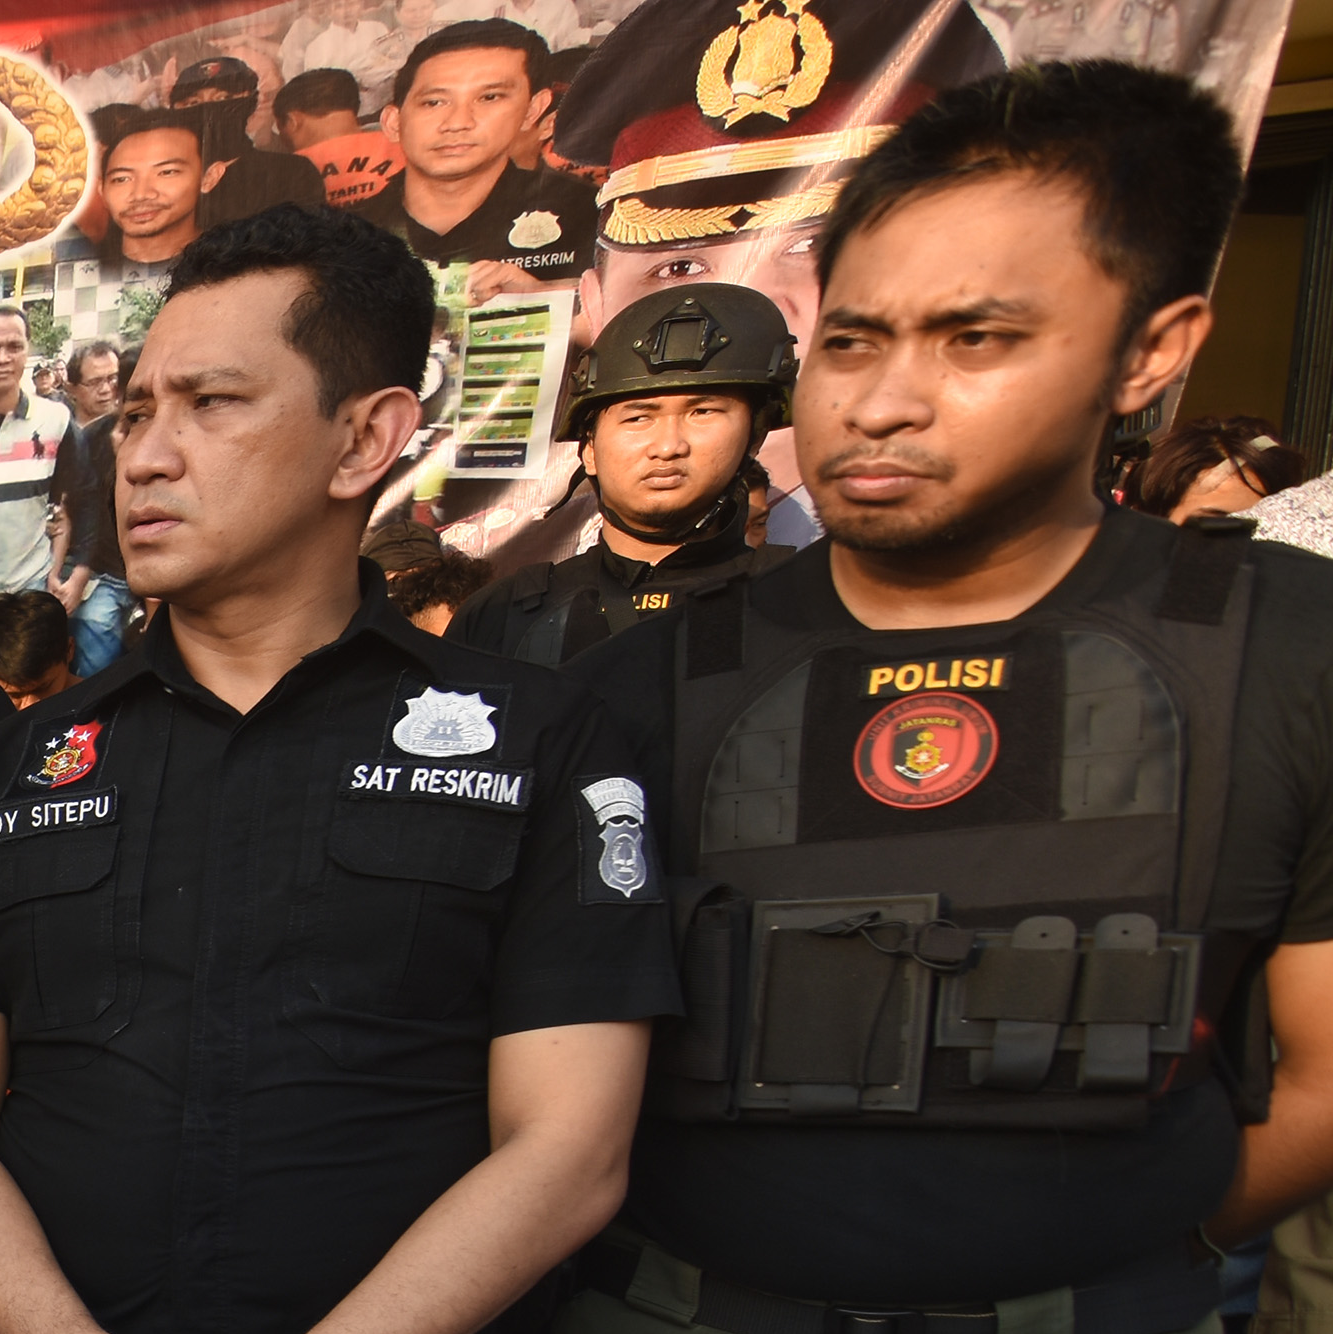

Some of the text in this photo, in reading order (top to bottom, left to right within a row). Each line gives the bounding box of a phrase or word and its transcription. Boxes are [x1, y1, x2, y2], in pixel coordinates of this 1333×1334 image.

[868, 658, 1006, 695] POLISI
[350, 764, 523, 806] SAT RESKRIM
[31, 795, 110, 828] SITEPU
